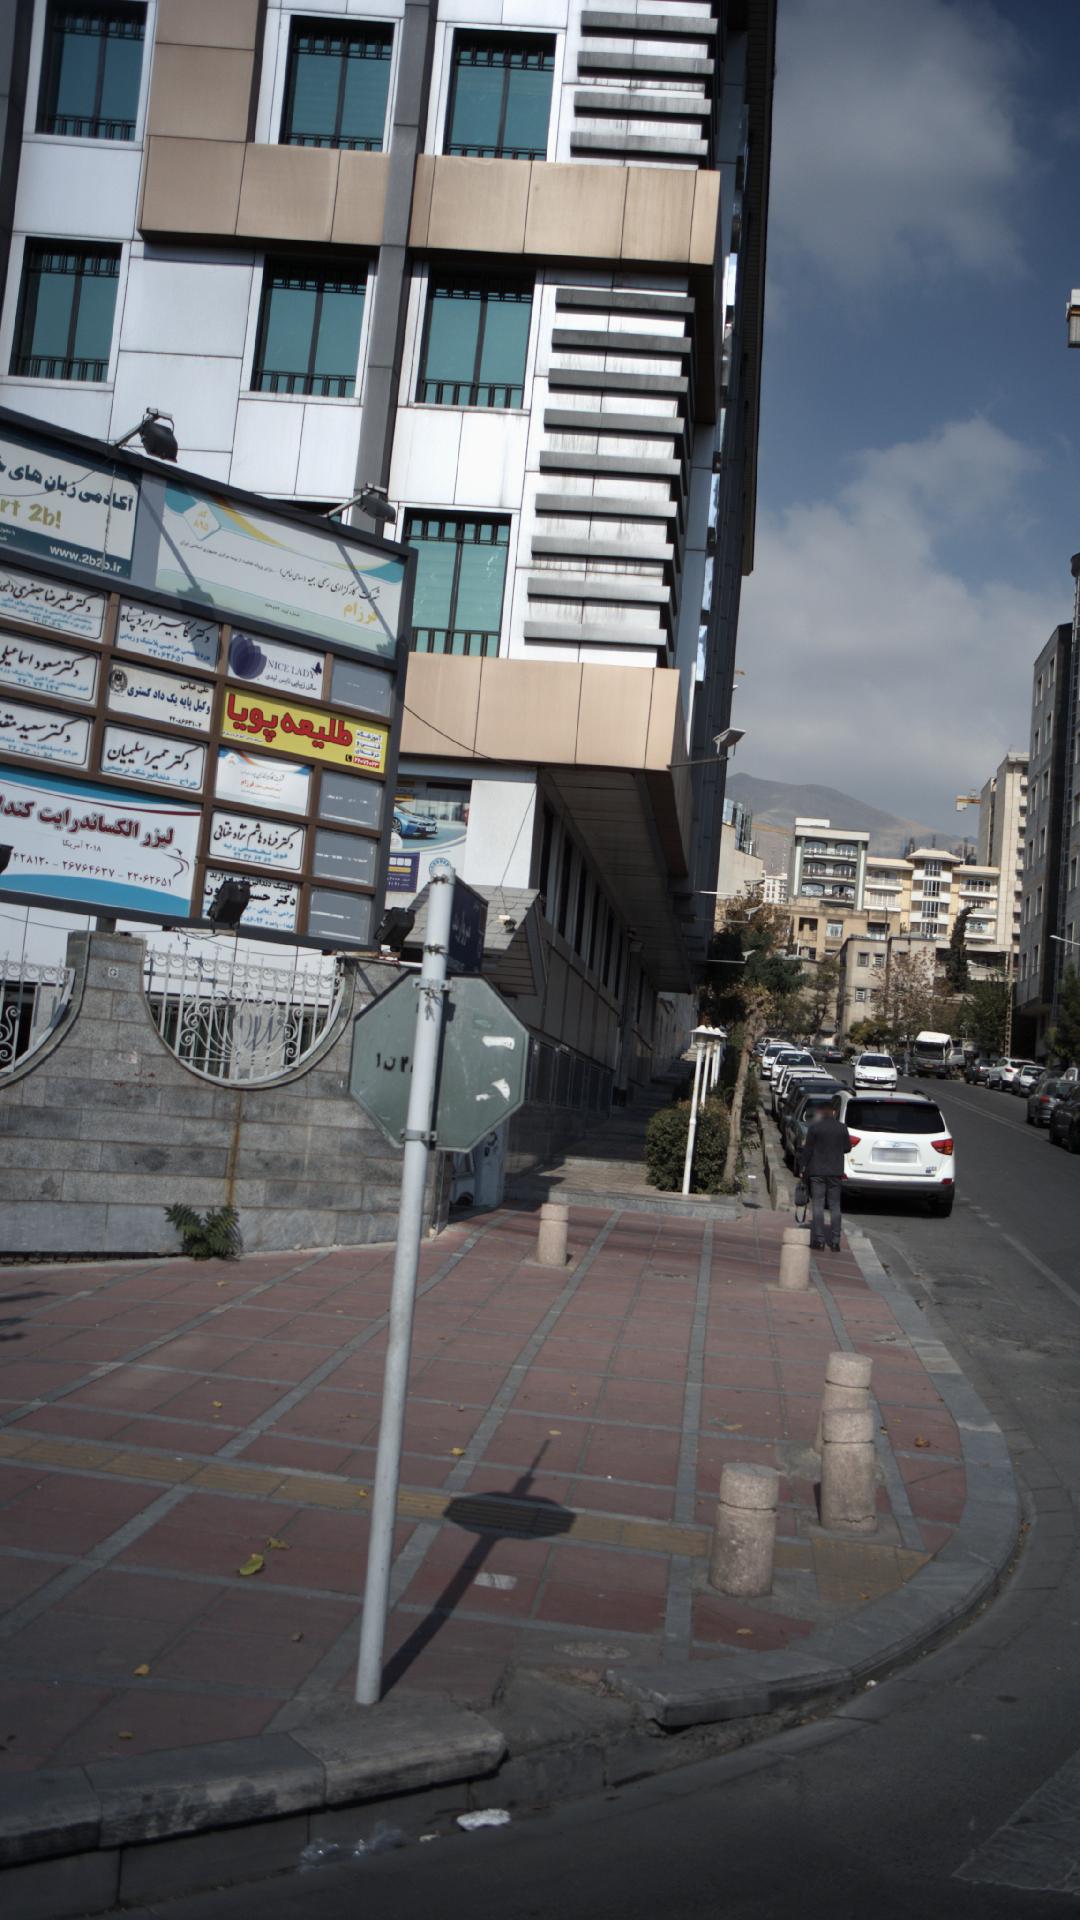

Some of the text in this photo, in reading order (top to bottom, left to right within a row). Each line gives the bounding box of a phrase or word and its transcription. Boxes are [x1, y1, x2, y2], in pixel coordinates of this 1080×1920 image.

[8, 464, 43, 485] های
[44, 474, 77, 498] زبان
[188, 622, 218, 644] دکتر
[34, 659, 62, 672] مسعود
[53, 653, 92, 678] دکتر
[166, 692, 179, 706] یک
[180, 696, 193, 712] پایه
[193, 699, 211, 716] وکیل
[37, 717, 82, 743] دکتر
[227, 692, 354, 750] طلیعه پویا
[165, 745, 201, 771] دکتر
[140, 825, 175, 851] لیزر
[274, 827, 300, 850] دکتر
